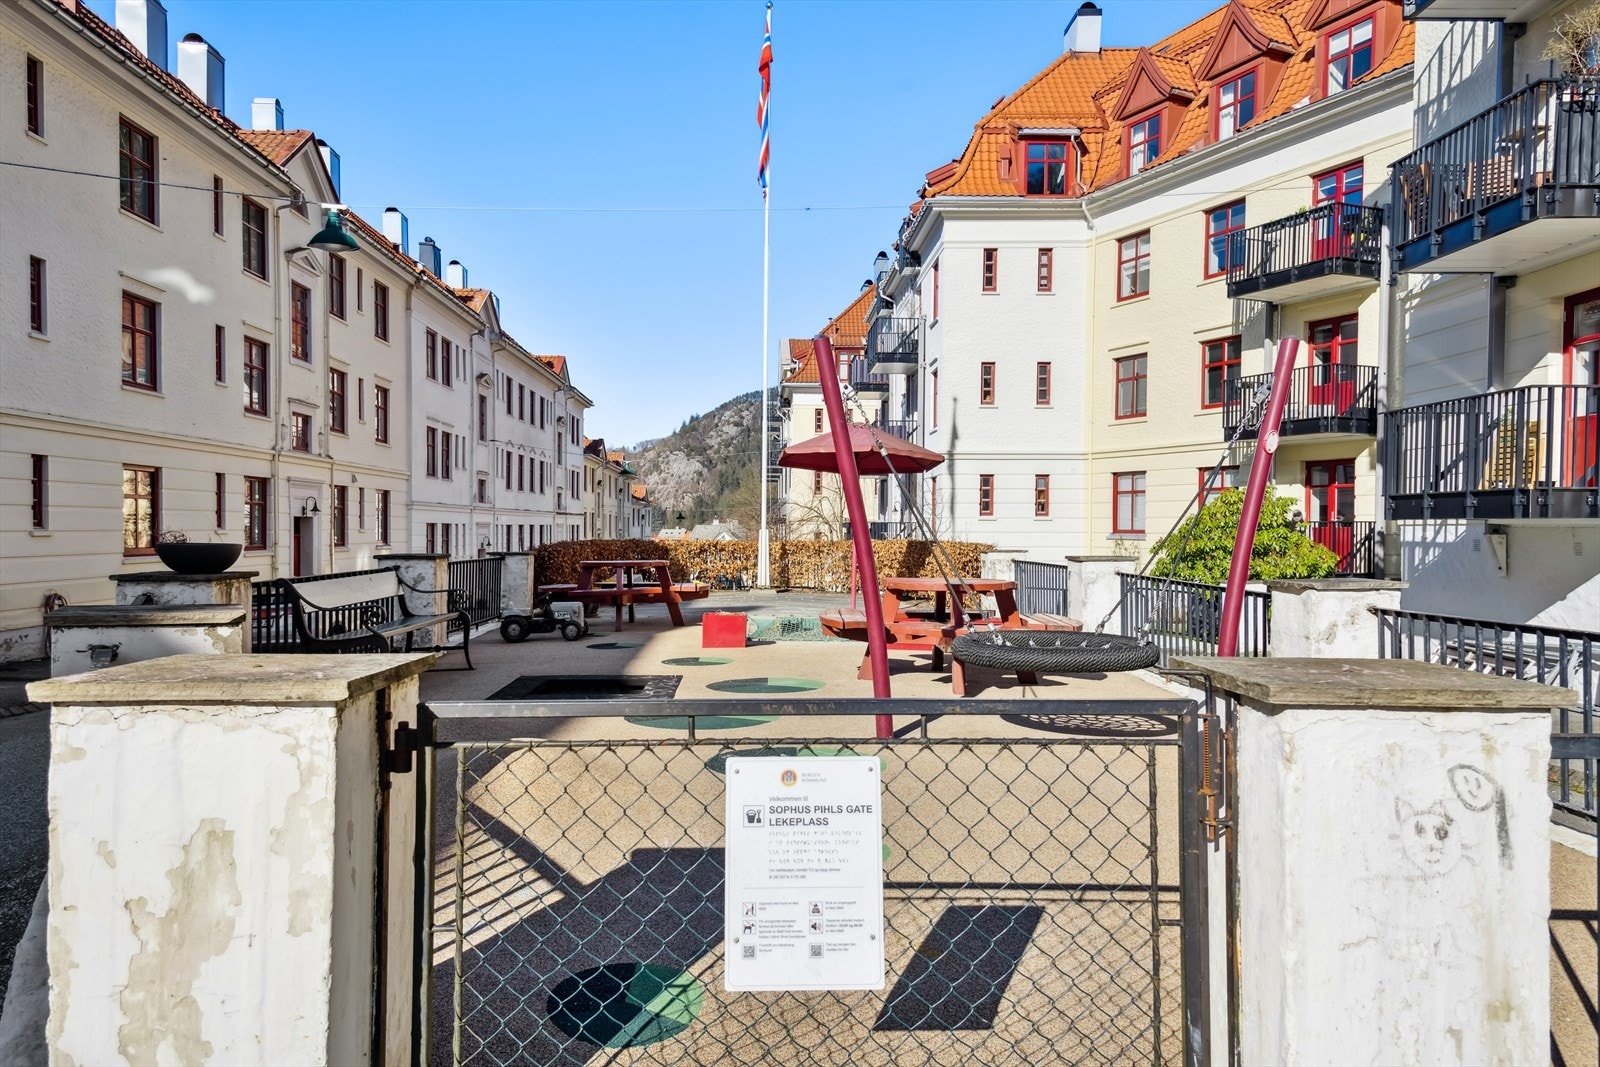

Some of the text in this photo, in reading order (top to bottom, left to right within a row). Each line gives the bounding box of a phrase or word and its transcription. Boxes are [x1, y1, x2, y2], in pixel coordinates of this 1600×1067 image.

[769, 804, 873, 814] SOPHUS PIHLS GATE
[769, 817, 829, 826] LEKEPLASS
